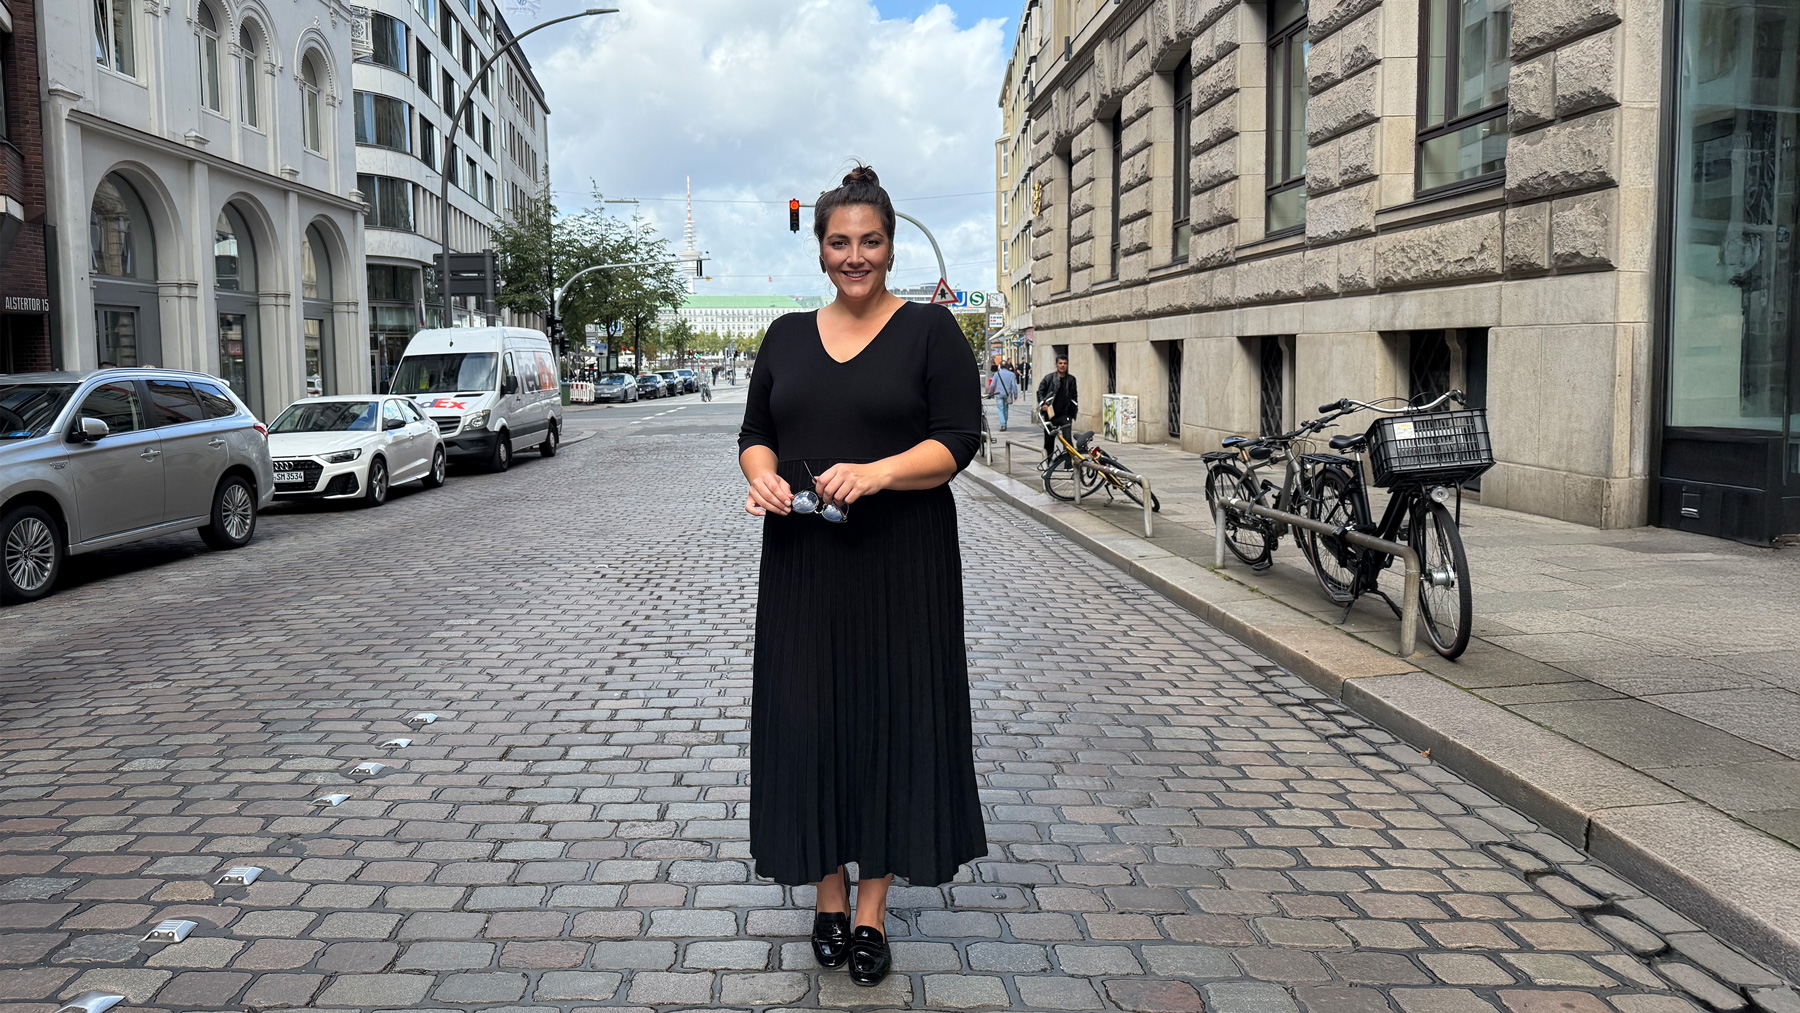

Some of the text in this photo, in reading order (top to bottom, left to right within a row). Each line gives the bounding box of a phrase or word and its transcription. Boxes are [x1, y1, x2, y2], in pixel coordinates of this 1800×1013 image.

[5, 296, 50, 312] ALSTERTOR 15
[971, 292, 983, 305] S
[276, 472, 303, 481] SM 3534
